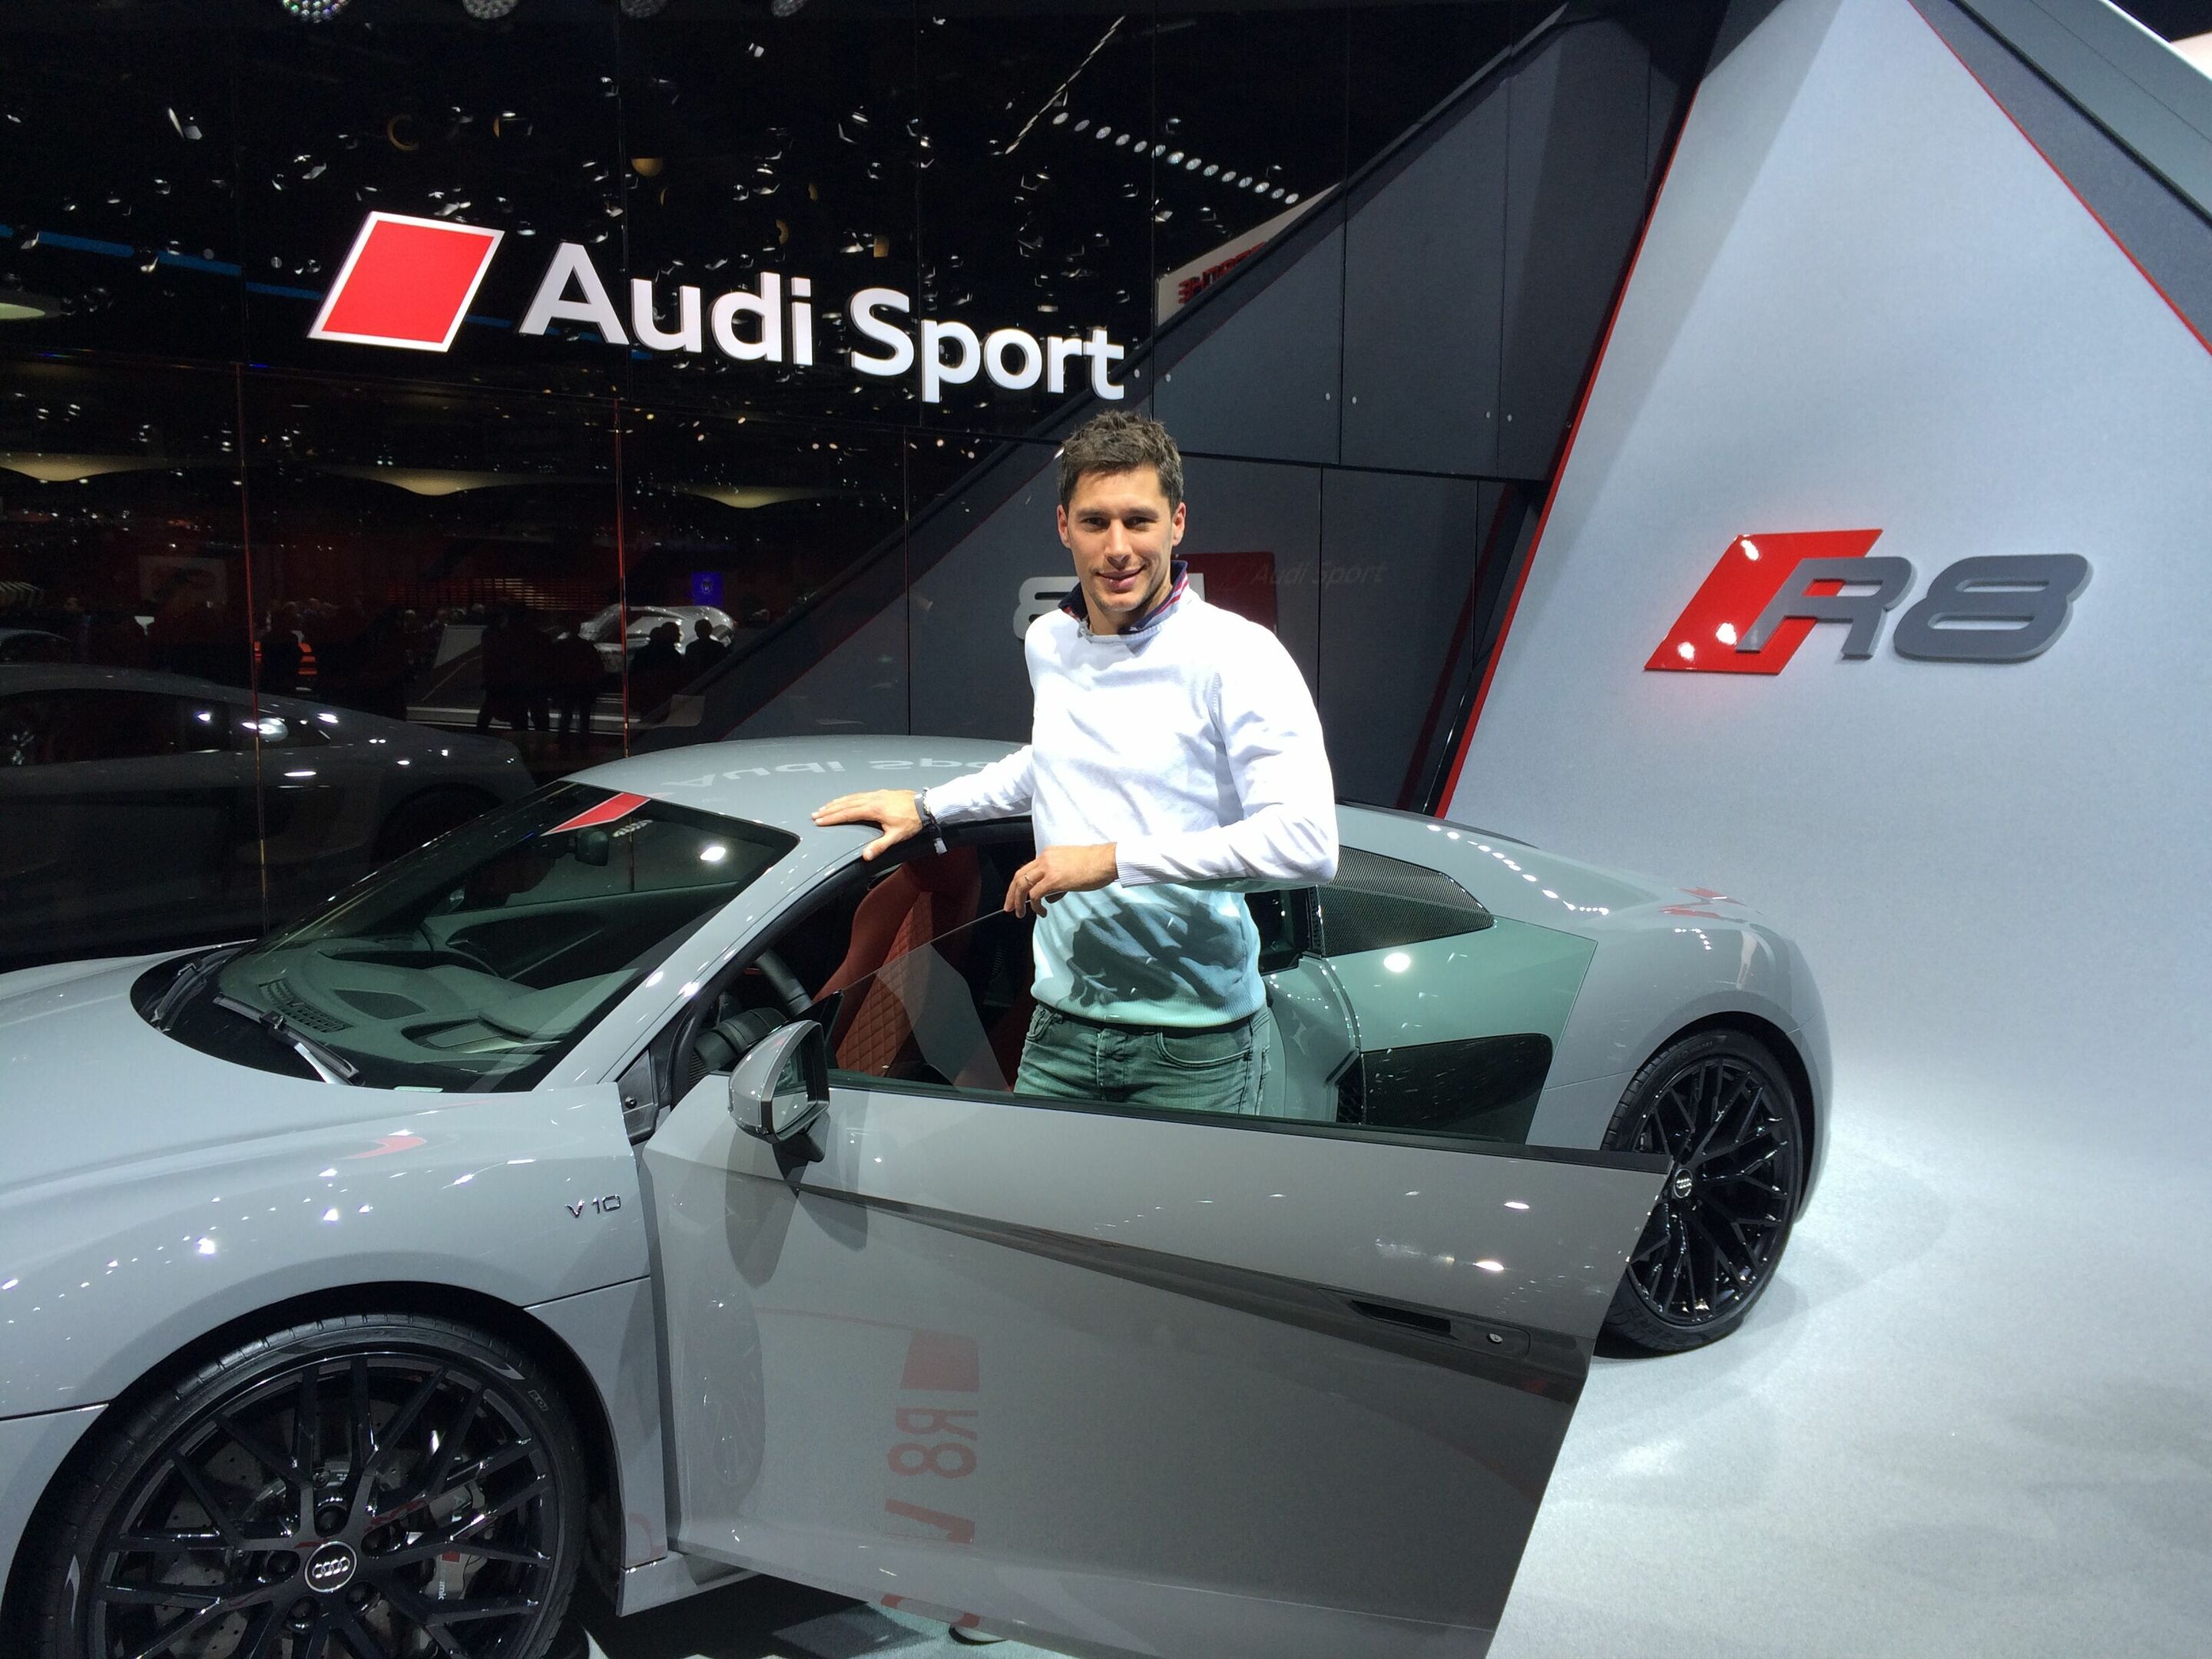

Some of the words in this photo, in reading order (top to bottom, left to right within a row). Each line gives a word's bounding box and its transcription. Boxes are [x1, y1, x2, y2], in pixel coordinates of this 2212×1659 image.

[518, 242, 814, 366] Audi
[849, 287, 1125, 403] Sport
[1735, 552, 2094, 664] R8
[565, 1194, 621, 1219] V10
